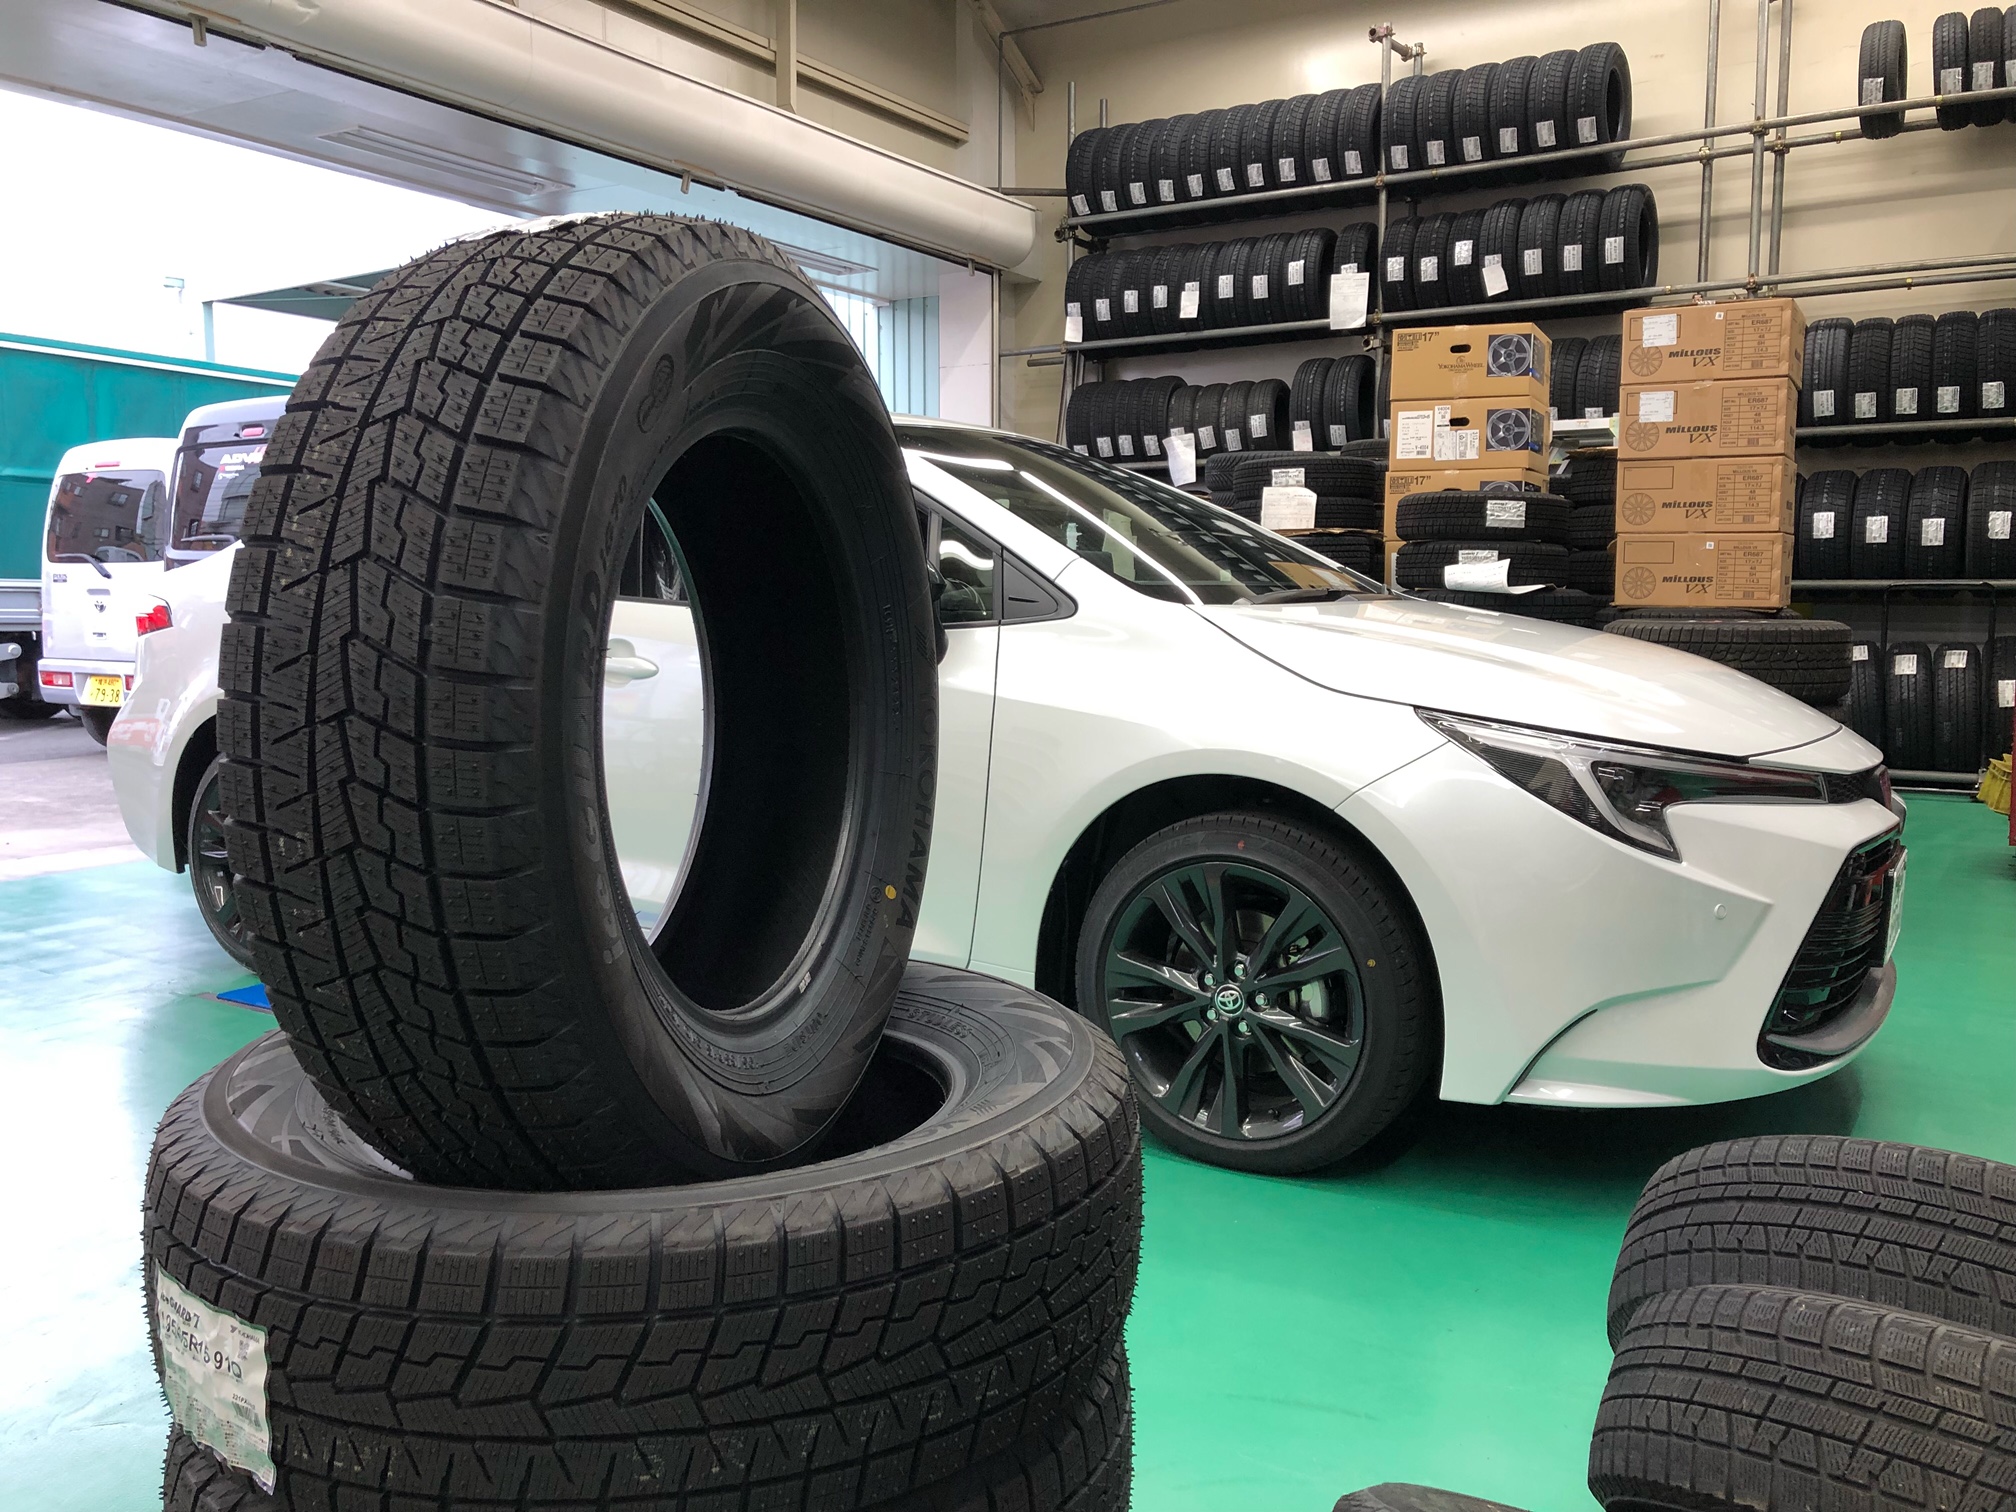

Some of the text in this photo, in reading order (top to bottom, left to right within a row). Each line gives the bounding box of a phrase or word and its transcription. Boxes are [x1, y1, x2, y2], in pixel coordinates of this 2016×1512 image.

[1692, 355, 1721, 368] VX
[1689, 432, 1718, 444] VX
[1685, 508, 1712, 519] VX
[1685, 583, 1713, 594] VX
[907, 1007, 975, 1039] STUDLESS
